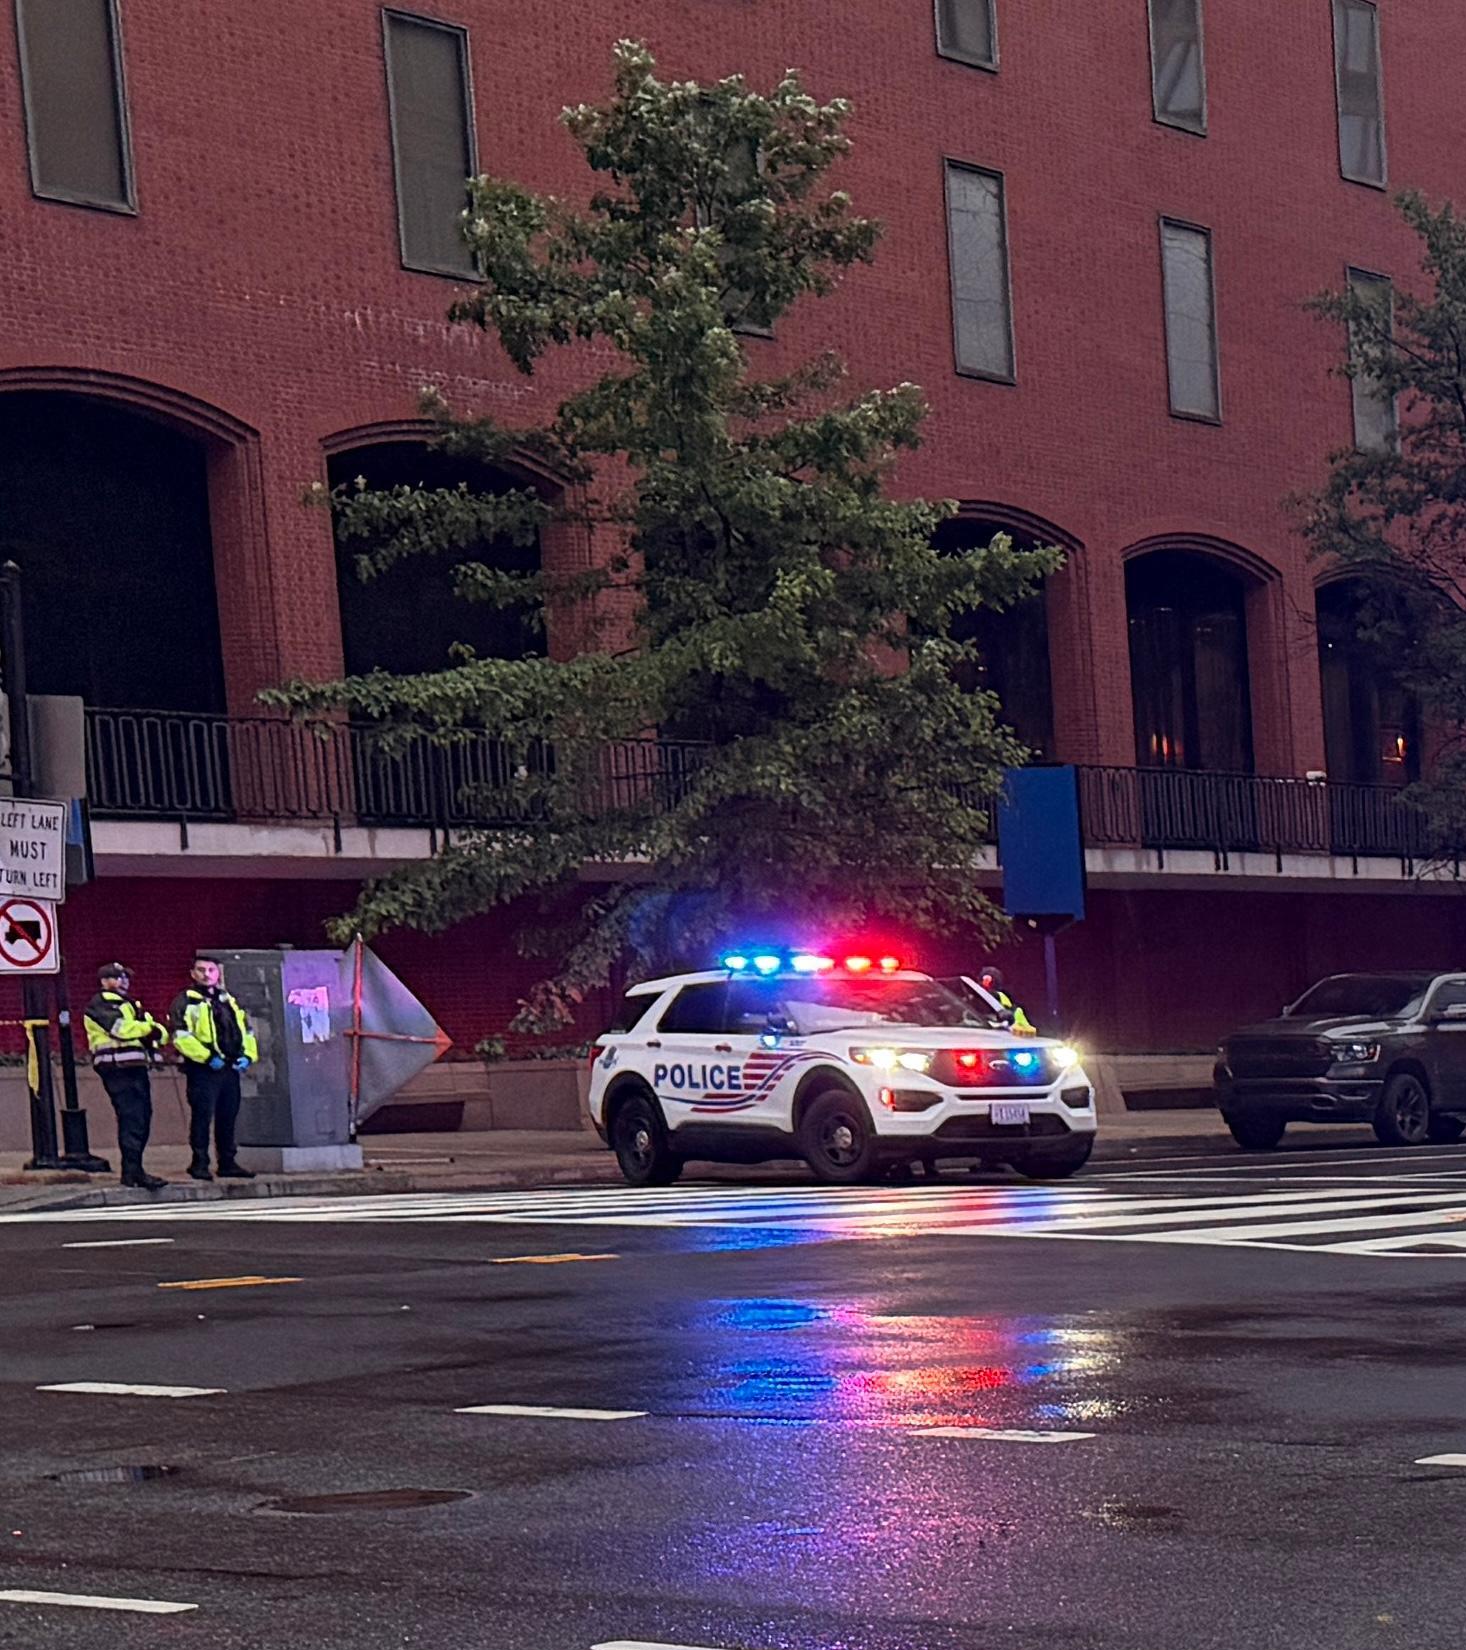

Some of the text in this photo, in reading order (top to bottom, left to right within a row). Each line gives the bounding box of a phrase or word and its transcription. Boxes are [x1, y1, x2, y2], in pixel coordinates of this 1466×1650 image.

[1, 812, 59, 831] LEFT LANE
[10, 840, 47, 860] MUST
[33, 872, 58, 889] LEFT
[654, 1063, 742, 1091] POLICE
